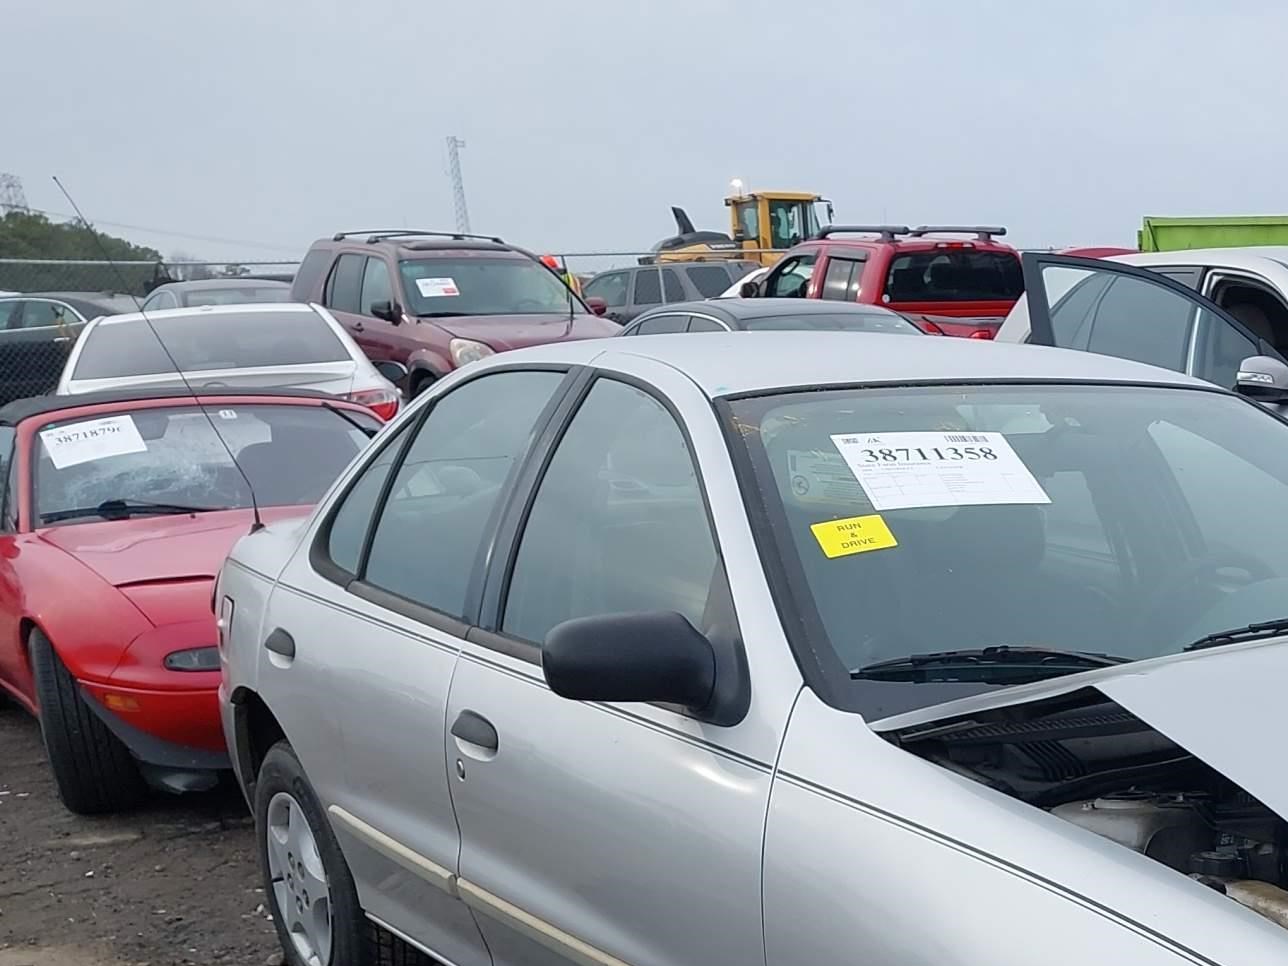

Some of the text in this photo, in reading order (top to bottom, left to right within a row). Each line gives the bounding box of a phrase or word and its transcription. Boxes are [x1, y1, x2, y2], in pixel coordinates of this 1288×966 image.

[862, 446, 998, 463] 38711358
[836, 522, 862, 532] RUN
[841, 537, 877, 549] DRIVE
